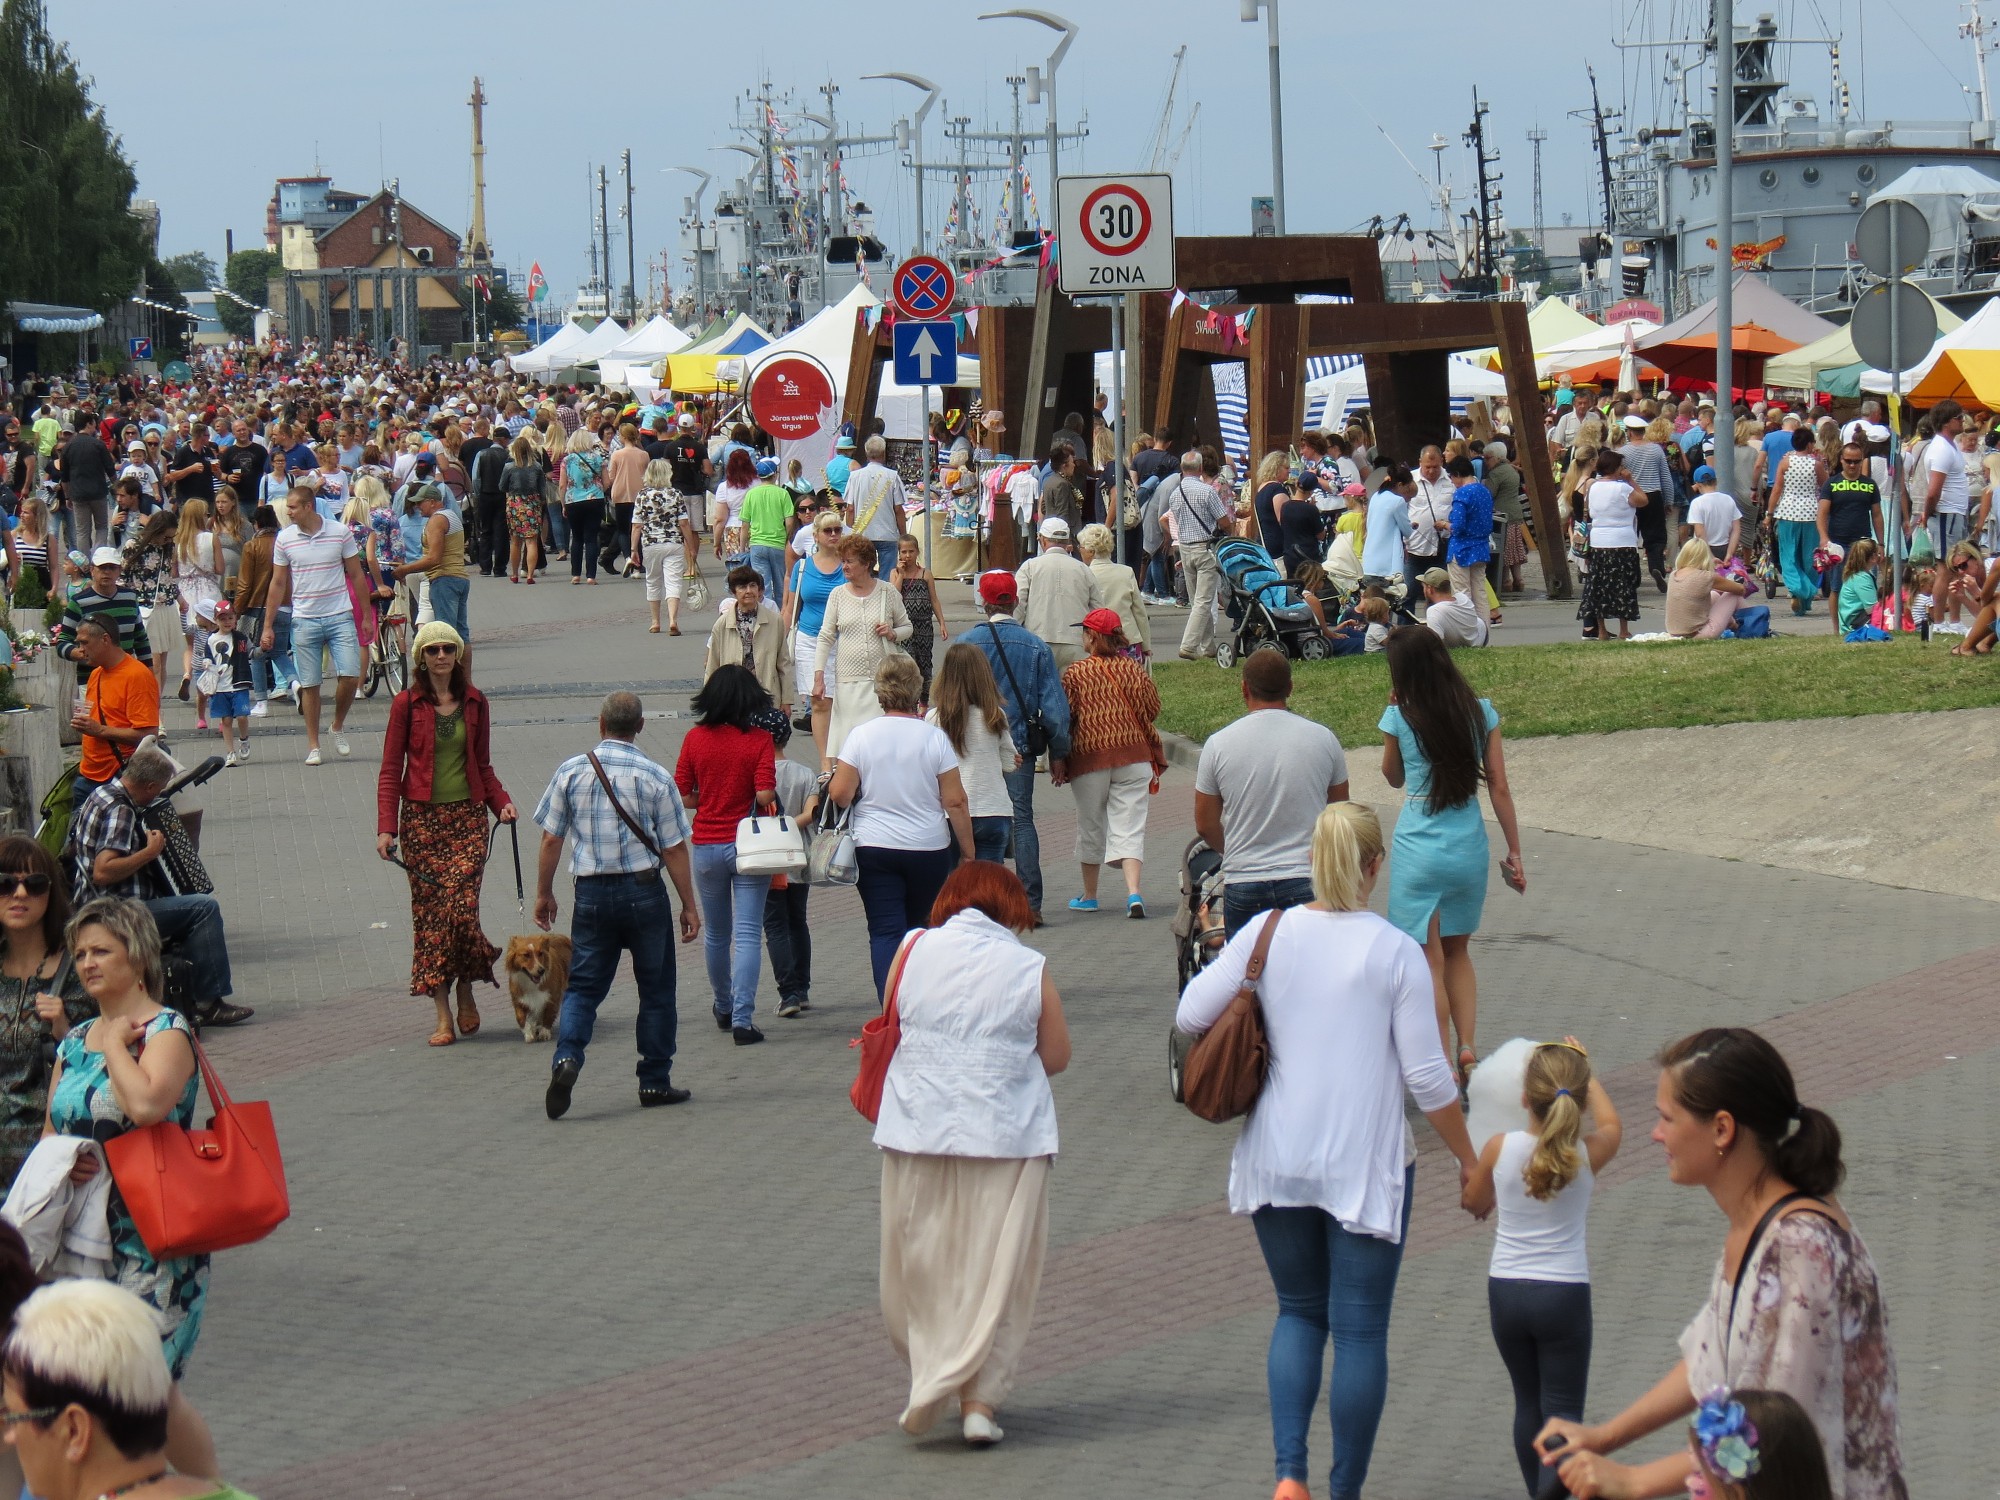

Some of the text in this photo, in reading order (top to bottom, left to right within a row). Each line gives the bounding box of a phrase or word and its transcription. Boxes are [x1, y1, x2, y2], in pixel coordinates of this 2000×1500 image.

[1100, 205, 1133, 238] 30
[1089, 266, 1145, 284] ZONA
[781, 423, 801, 431] tirgus
[1831, 480, 1874, 493] adidas
